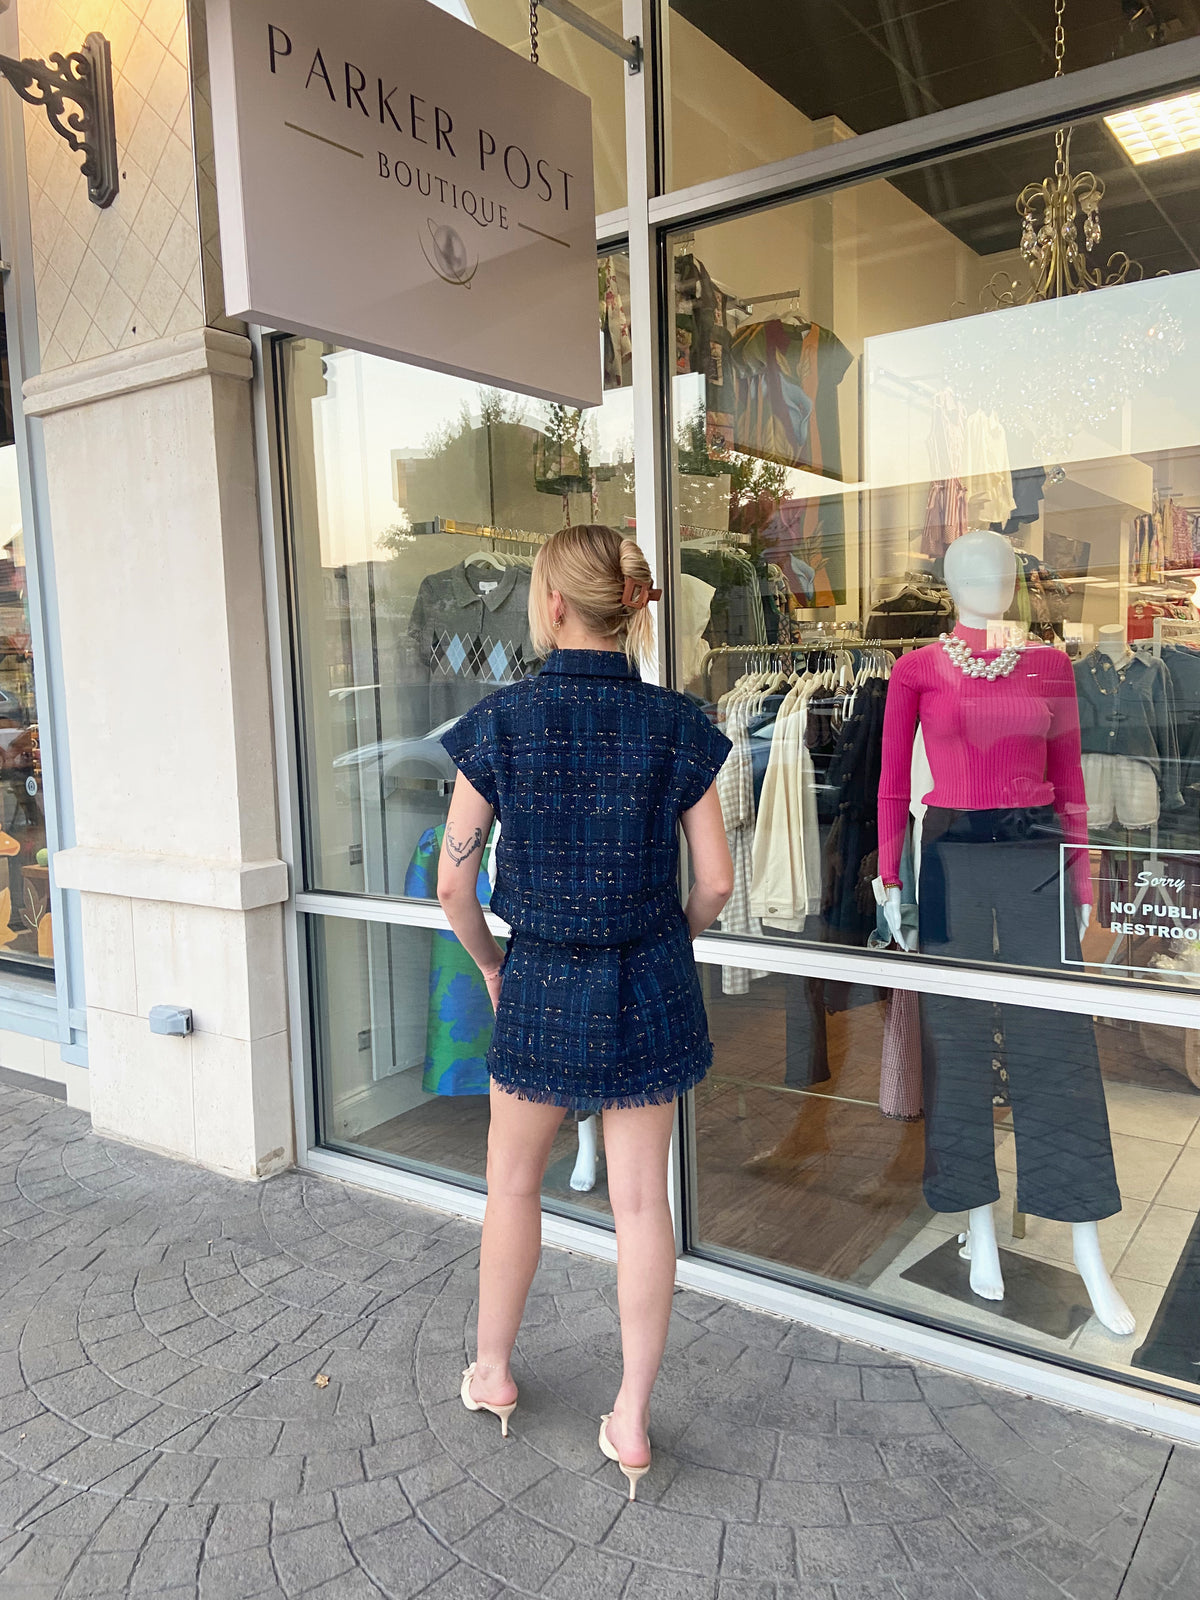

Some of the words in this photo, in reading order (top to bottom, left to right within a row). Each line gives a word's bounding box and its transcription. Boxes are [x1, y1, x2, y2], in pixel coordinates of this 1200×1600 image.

[267, 23, 457, 158] PARKER
[478, 128, 575, 211] POST
[376, 150, 510, 230] BOUTIQUE
[1134, 871, 1186, 894] Sorry
[1110, 901, 1137, 915] NO
[1142, 903, 1200, 920] PUBLI
[1110, 921, 1200, 941] RESTROO
